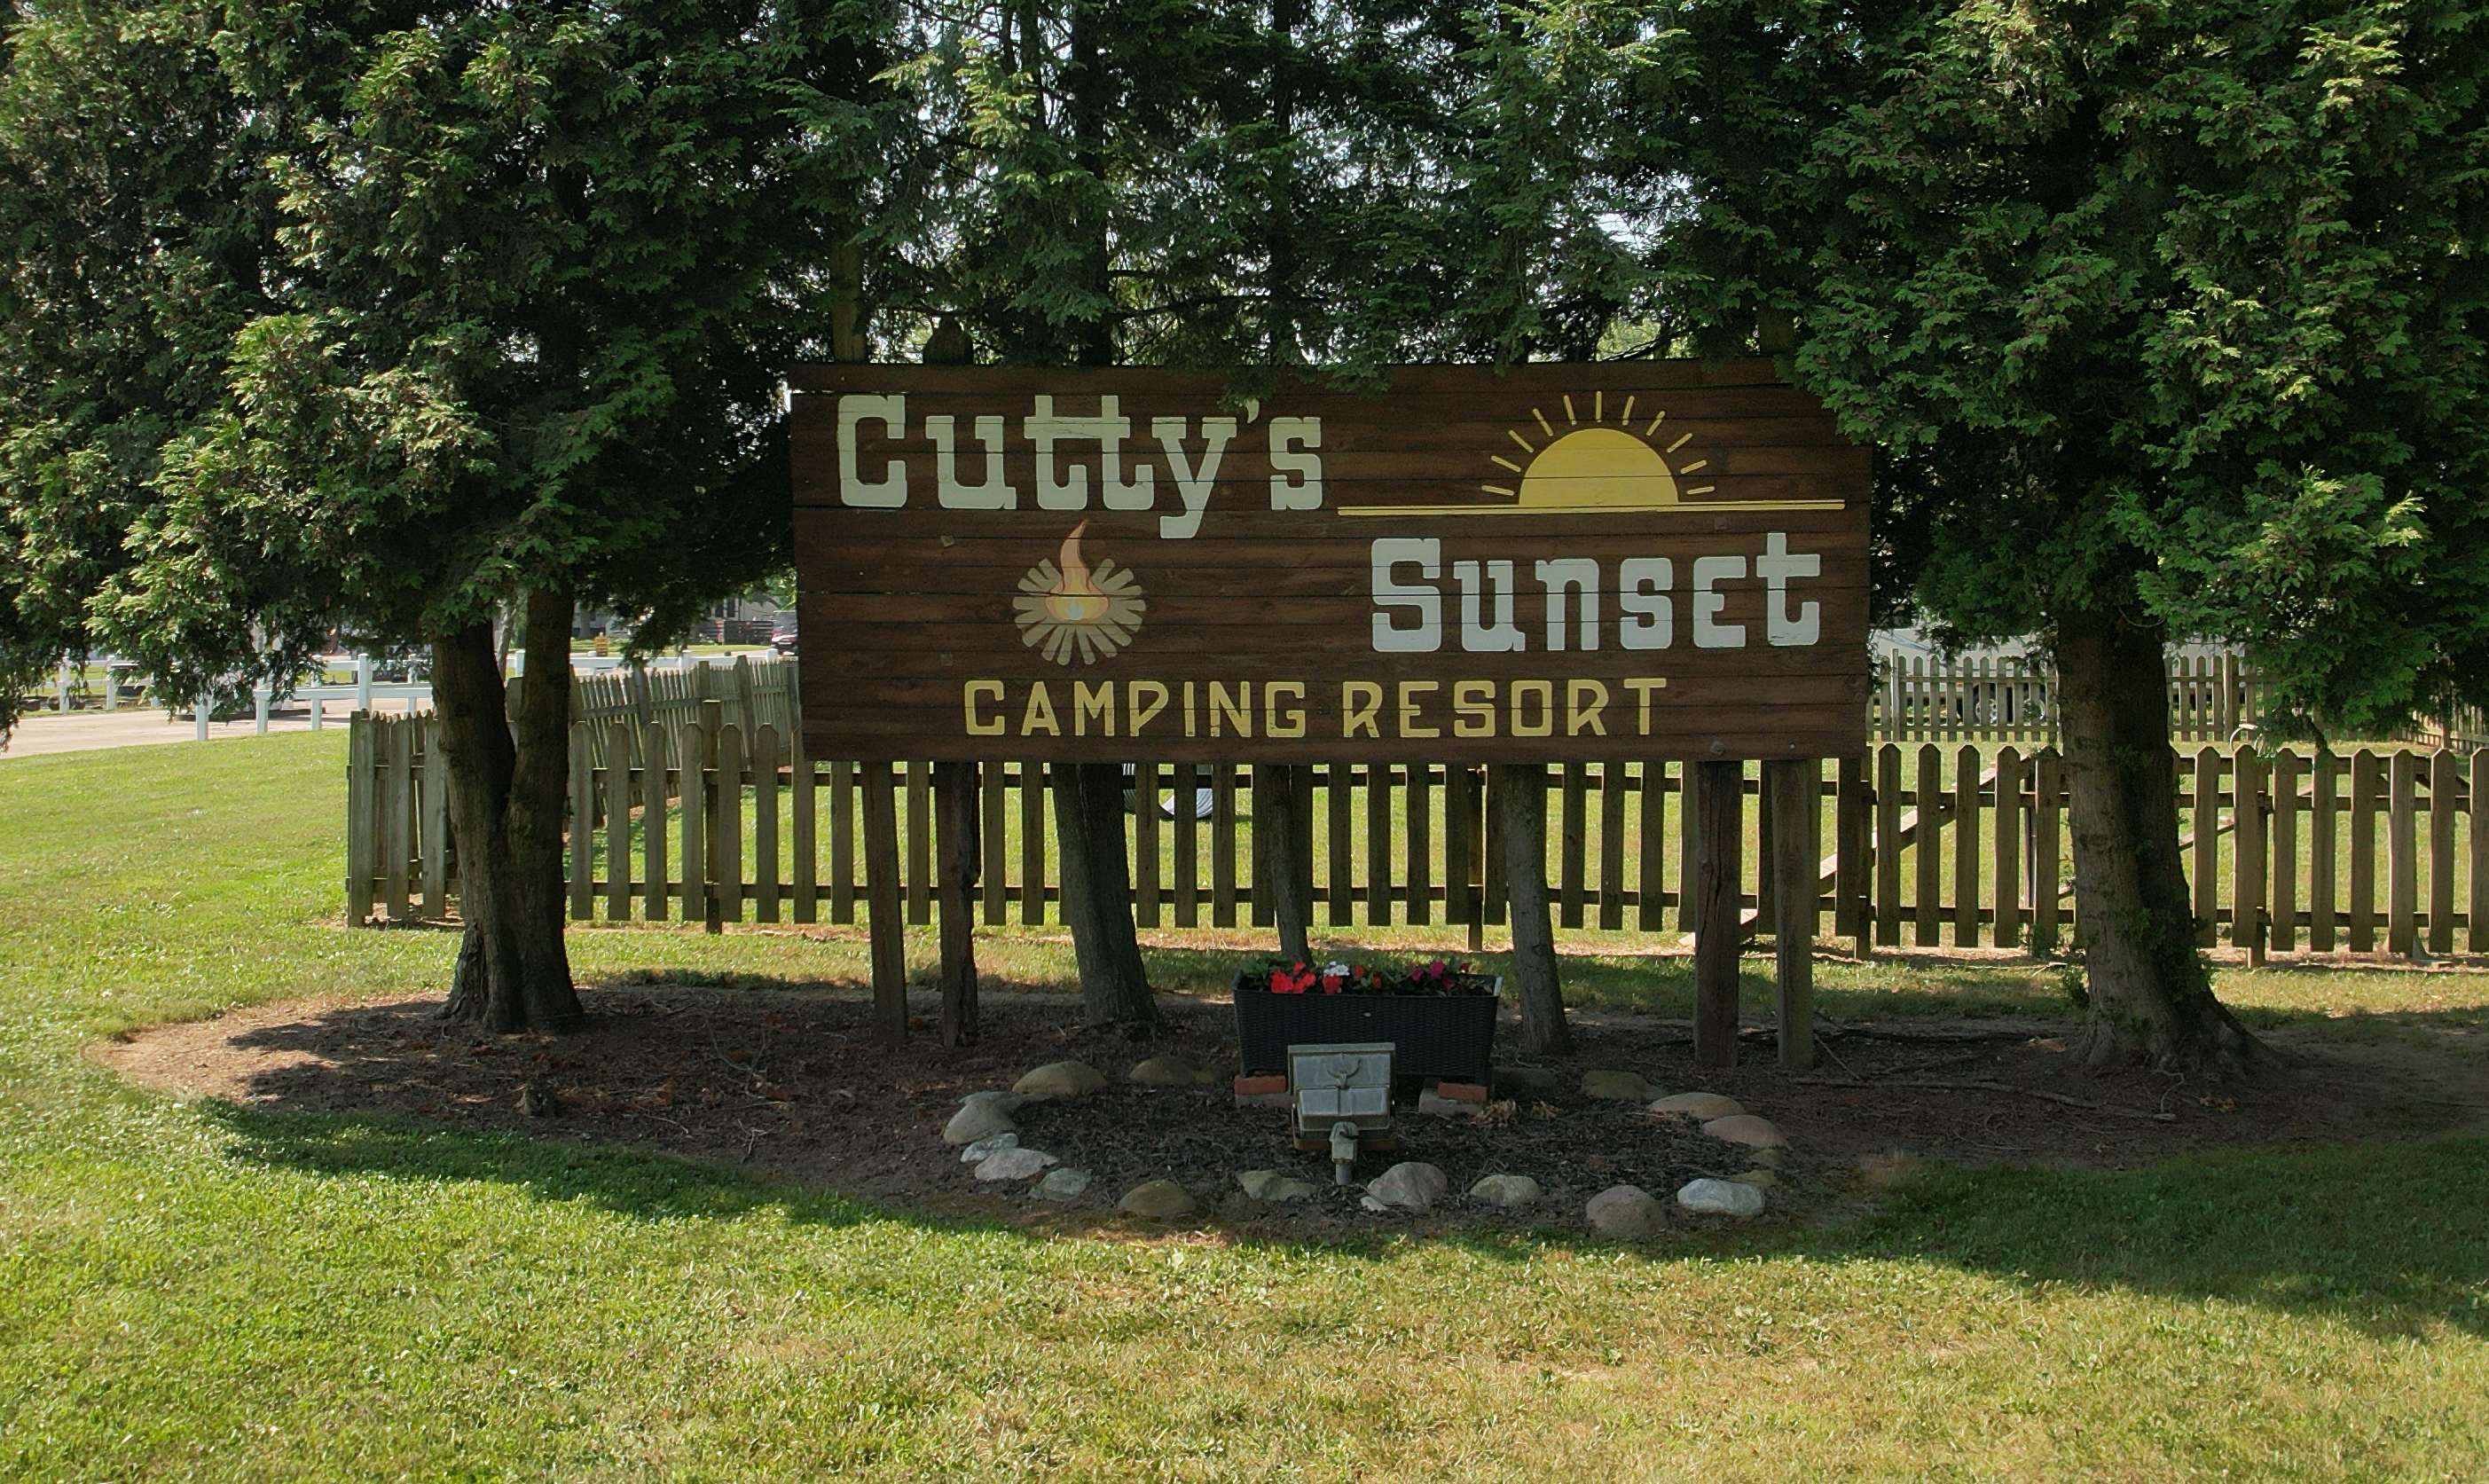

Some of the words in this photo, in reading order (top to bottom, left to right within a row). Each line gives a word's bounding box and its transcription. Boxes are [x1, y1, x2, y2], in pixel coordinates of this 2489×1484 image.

[837, 394, 1323, 539] Cutty's
[1370, 532, 1821, 653] Sunset
[965, 679, 1307, 738] CAMPING
[1342, 677, 1668, 738] RESORT
